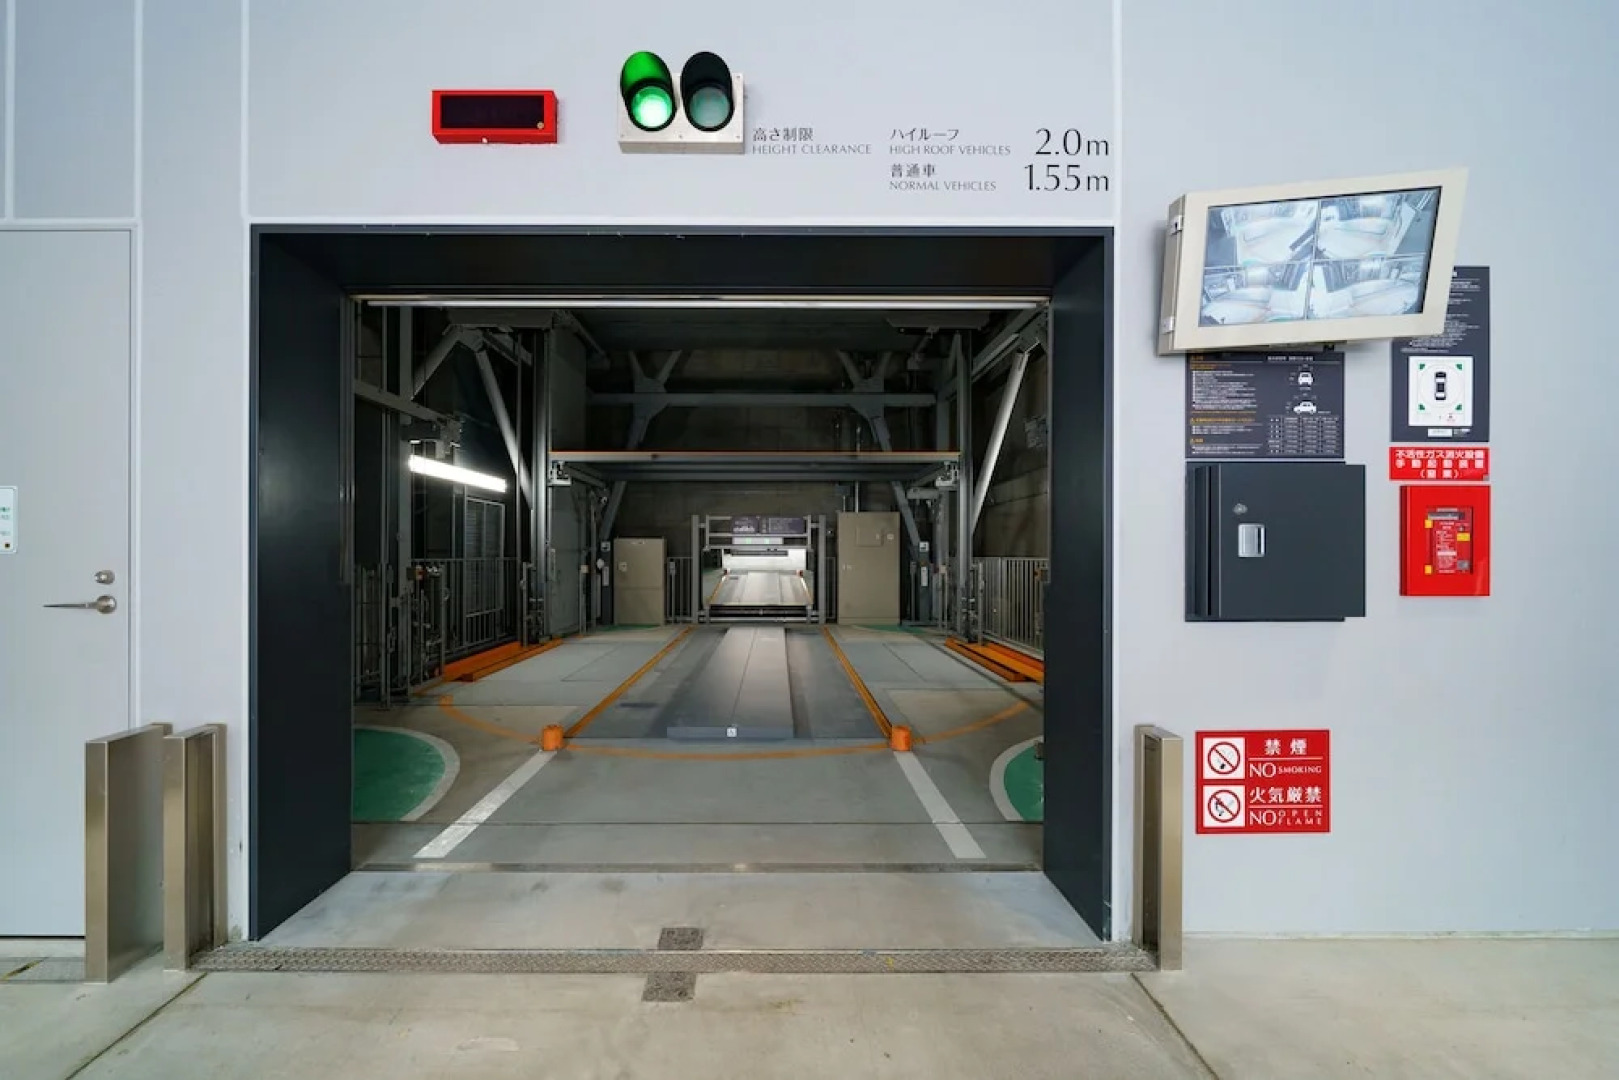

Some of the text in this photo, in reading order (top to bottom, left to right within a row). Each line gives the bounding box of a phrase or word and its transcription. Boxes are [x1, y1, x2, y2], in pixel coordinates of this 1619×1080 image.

[752, 127, 814, 141] 高さ制限
[890, 127, 960, 141] ハイルーフ
[752, 143, 872, 155] HEIGHT CLEARANCE
[890, 144, 1011, 156] HIGH ROOF VEHICLES
[891, 163, 938, 178] 普通車
[889, 180, 997, 192] NORMAL VEHICLES
[1264, 738, 1307, 756] 禁煙
[1249, 762, 1322, 778] NO SMOKING
[1249, 786, 1322, 804] 火気厳禁
[1249, 809, 1277, 826] NO
